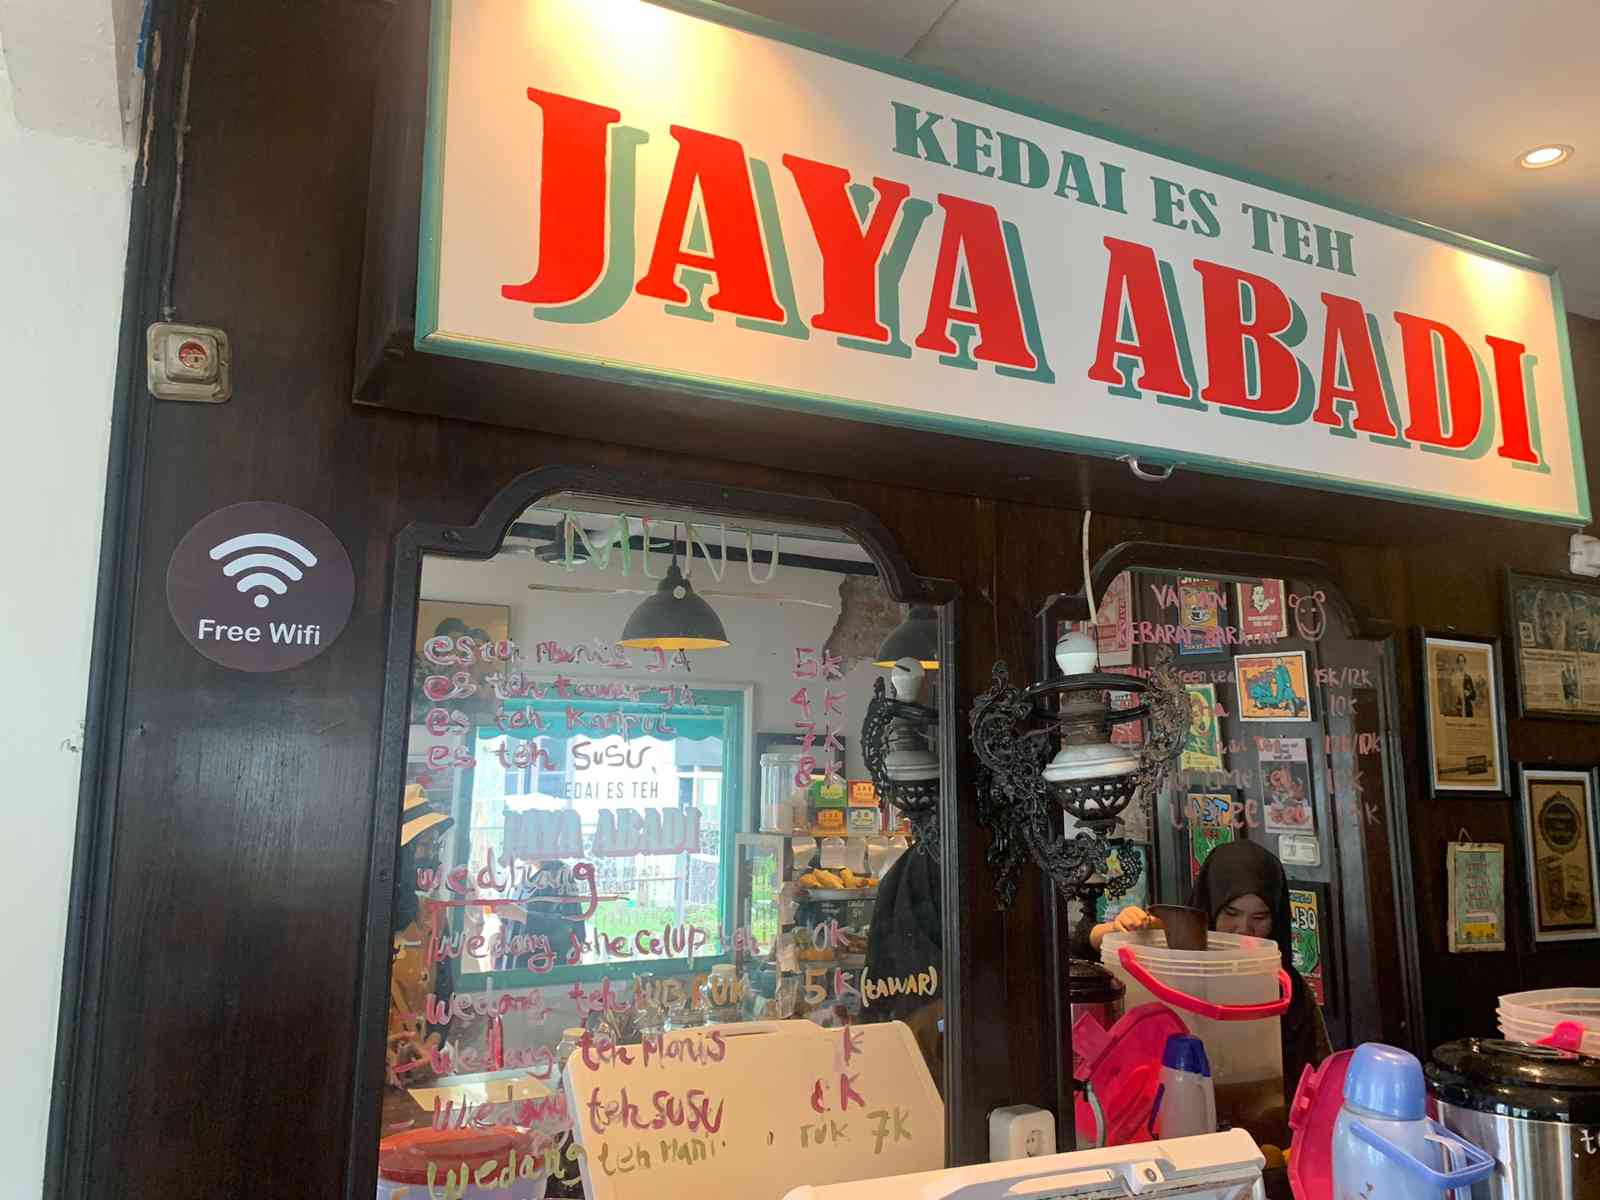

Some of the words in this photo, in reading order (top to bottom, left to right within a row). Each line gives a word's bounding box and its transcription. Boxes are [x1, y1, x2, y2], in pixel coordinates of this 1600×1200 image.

[890, 100, 1128, 216] KEDAI
[1150, 176, 1221, 238] ES
[1241, 203, 1357, 277] TEH
[500, 86, 1054, 383] JAYA
[1087, 235, 1551, 475] ABADI
[562, 509, 780, 584] MENU
[198, 618, 262, 644] Free
[269, 622, 321, 647] Wifi
[606, 781, 625, 800] ES
[631, 780, 659, 799] TEH
